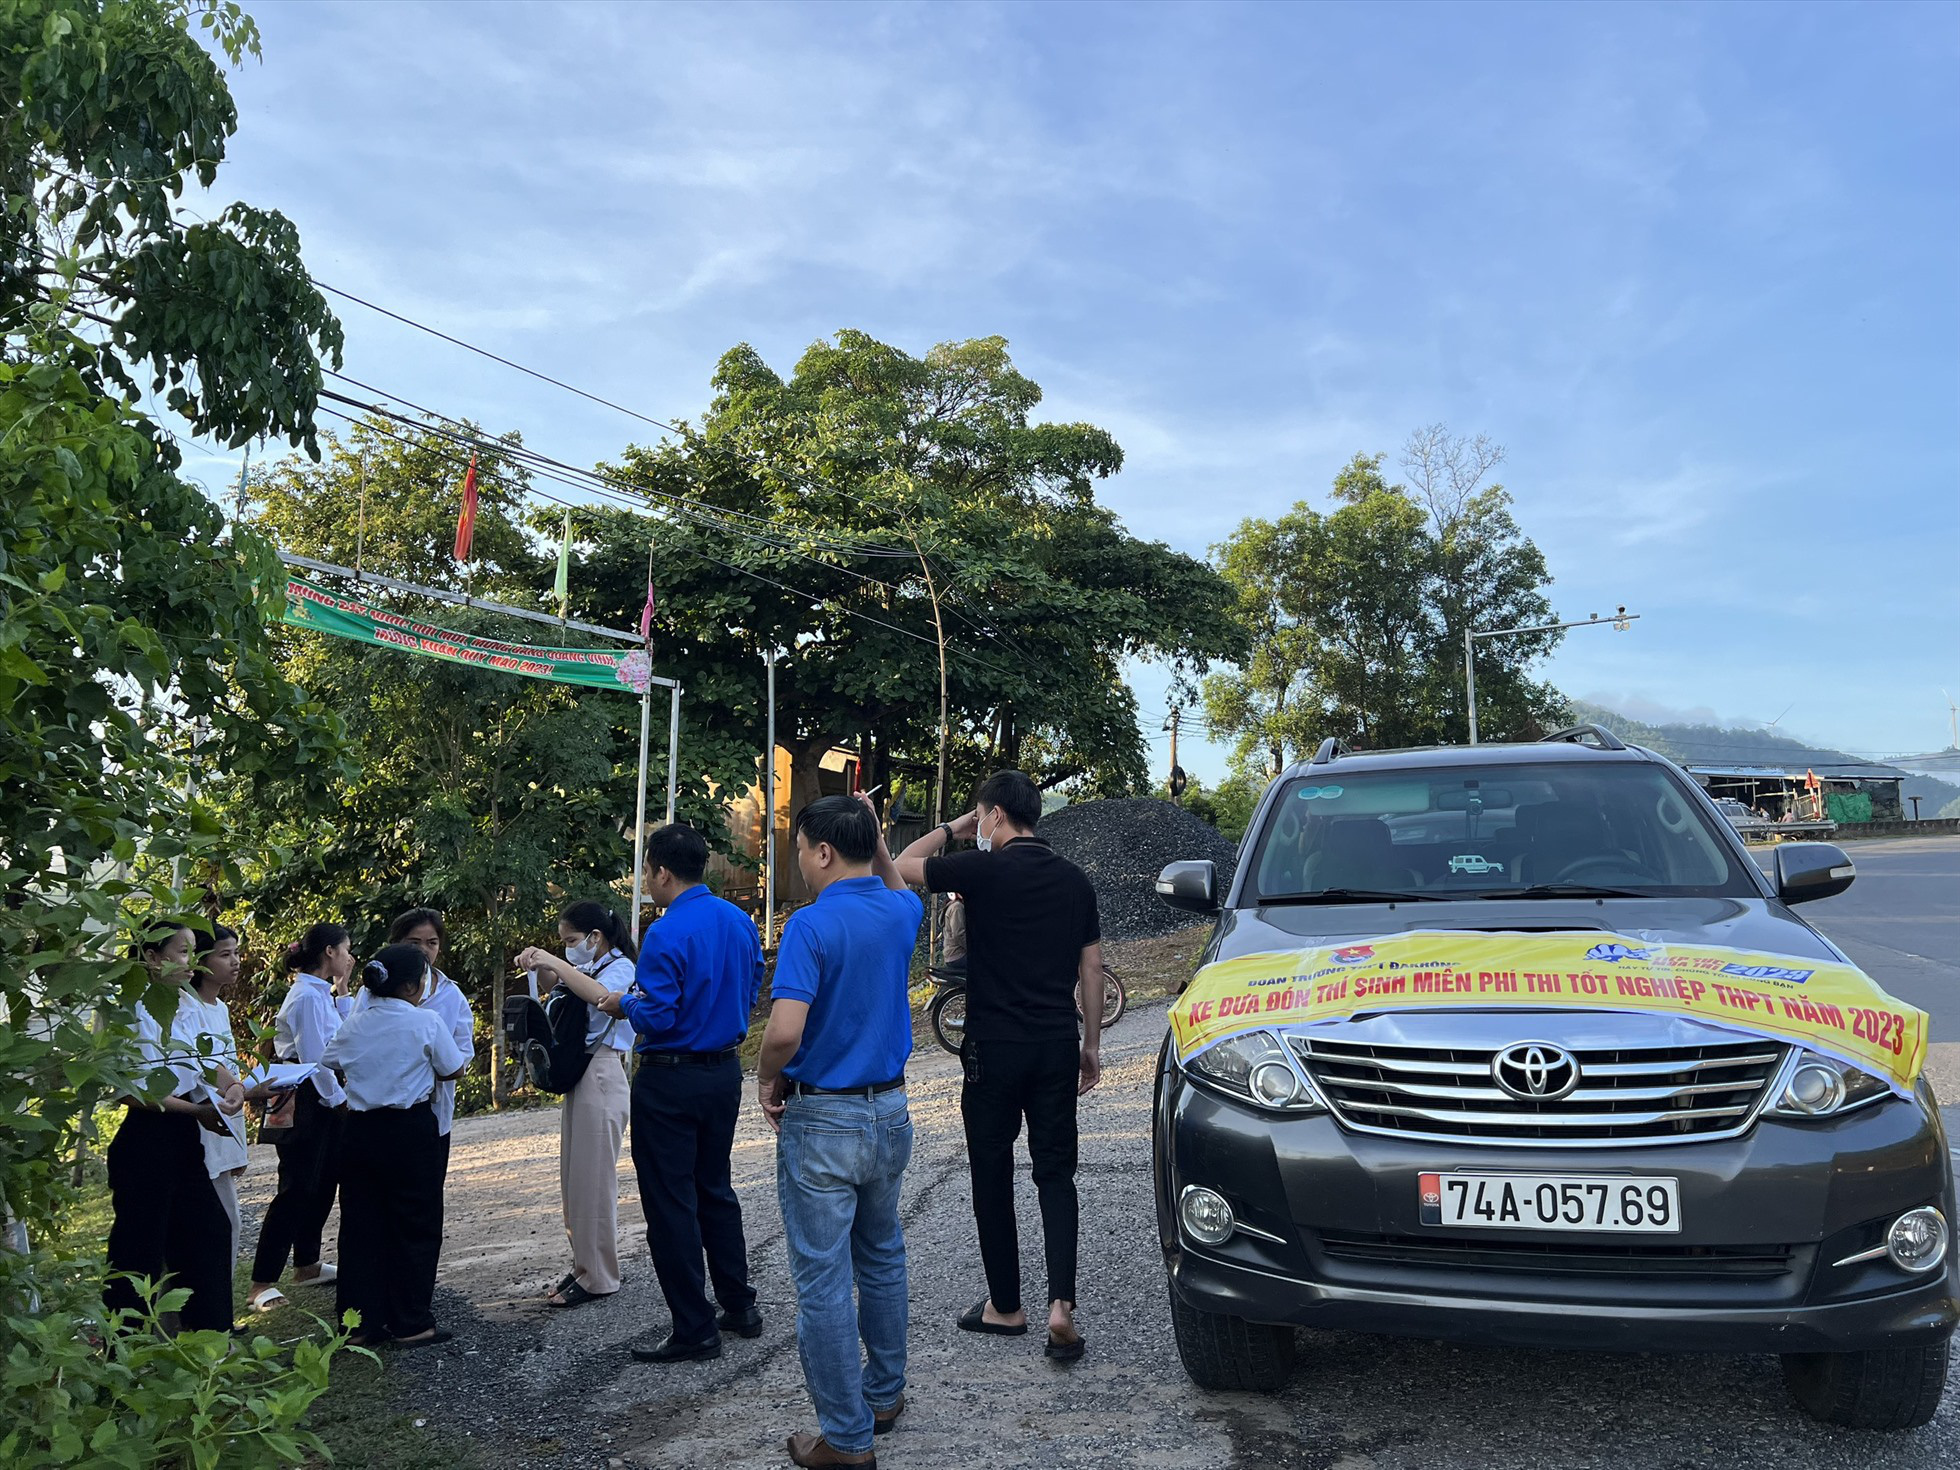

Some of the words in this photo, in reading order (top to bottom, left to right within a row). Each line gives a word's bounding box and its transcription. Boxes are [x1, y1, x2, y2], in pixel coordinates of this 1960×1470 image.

[420, 638, 461, 658] XUÂN
[1189, 1000, 1215, 1027] XE
[1218, 992, 1260, 1018] ĐƯA
[1266, 987, 1311, 1012] ĐÓN
[1317, 976, 1349, 1004] THÍ
[1353, 974, 1406, 998] SINH
[1479, 969, 1518, 993] PHÍ
[1523, 973, 1562, 993] THI
[1566, 968, 1608, 995] TỐT
[1615, 975, 1706, 1005] NGHIỆP
[1711, 983, 1776, 1015] THPT
[1779, 994, 1846, 1031] NĂM
[1847, 1007, 1905, 1056] 2023
[1447, 1180, 1671, 1226] 74A-057.69
